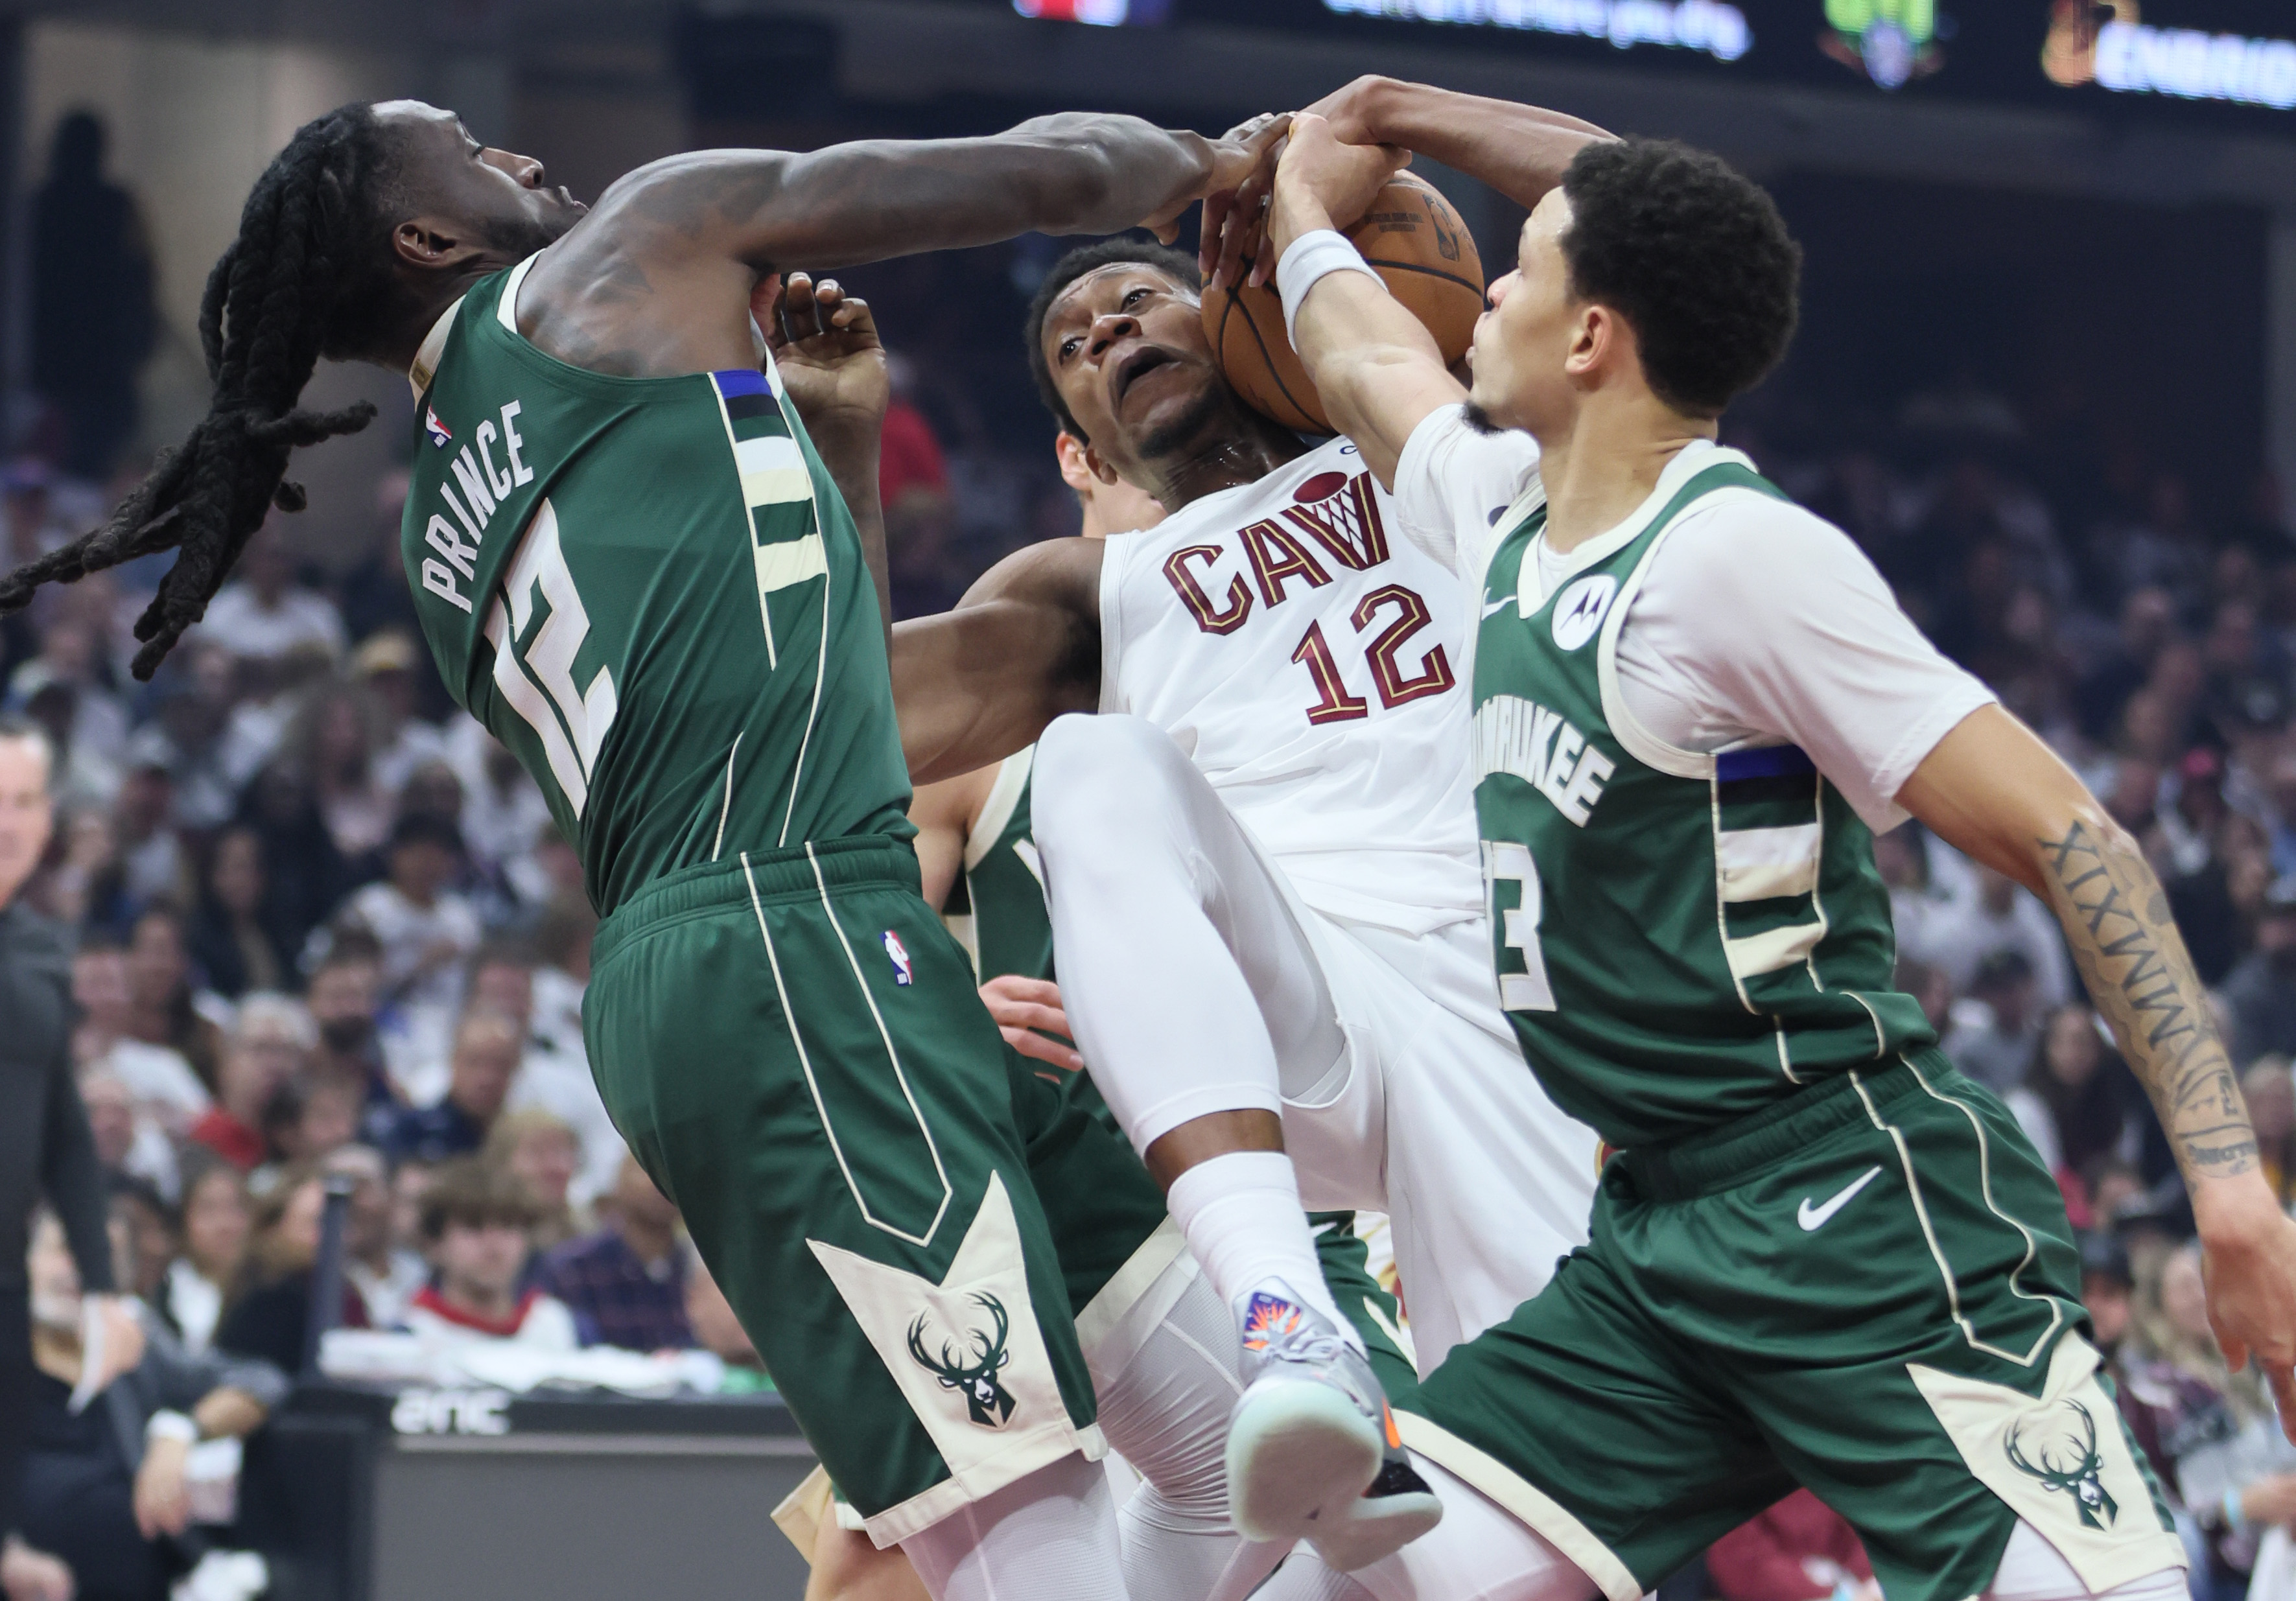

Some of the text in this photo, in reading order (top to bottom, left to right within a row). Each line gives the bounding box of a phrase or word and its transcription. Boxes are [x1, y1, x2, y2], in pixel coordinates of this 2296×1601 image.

[422, 399, 534, 614] PRINCE
[1162, 471, 1390, 636] CAV
[483, 497, 617, 821] 12
[1291, 583, 1455, 725] 12
[1472, 695, 1616, 828] WAUKEE
